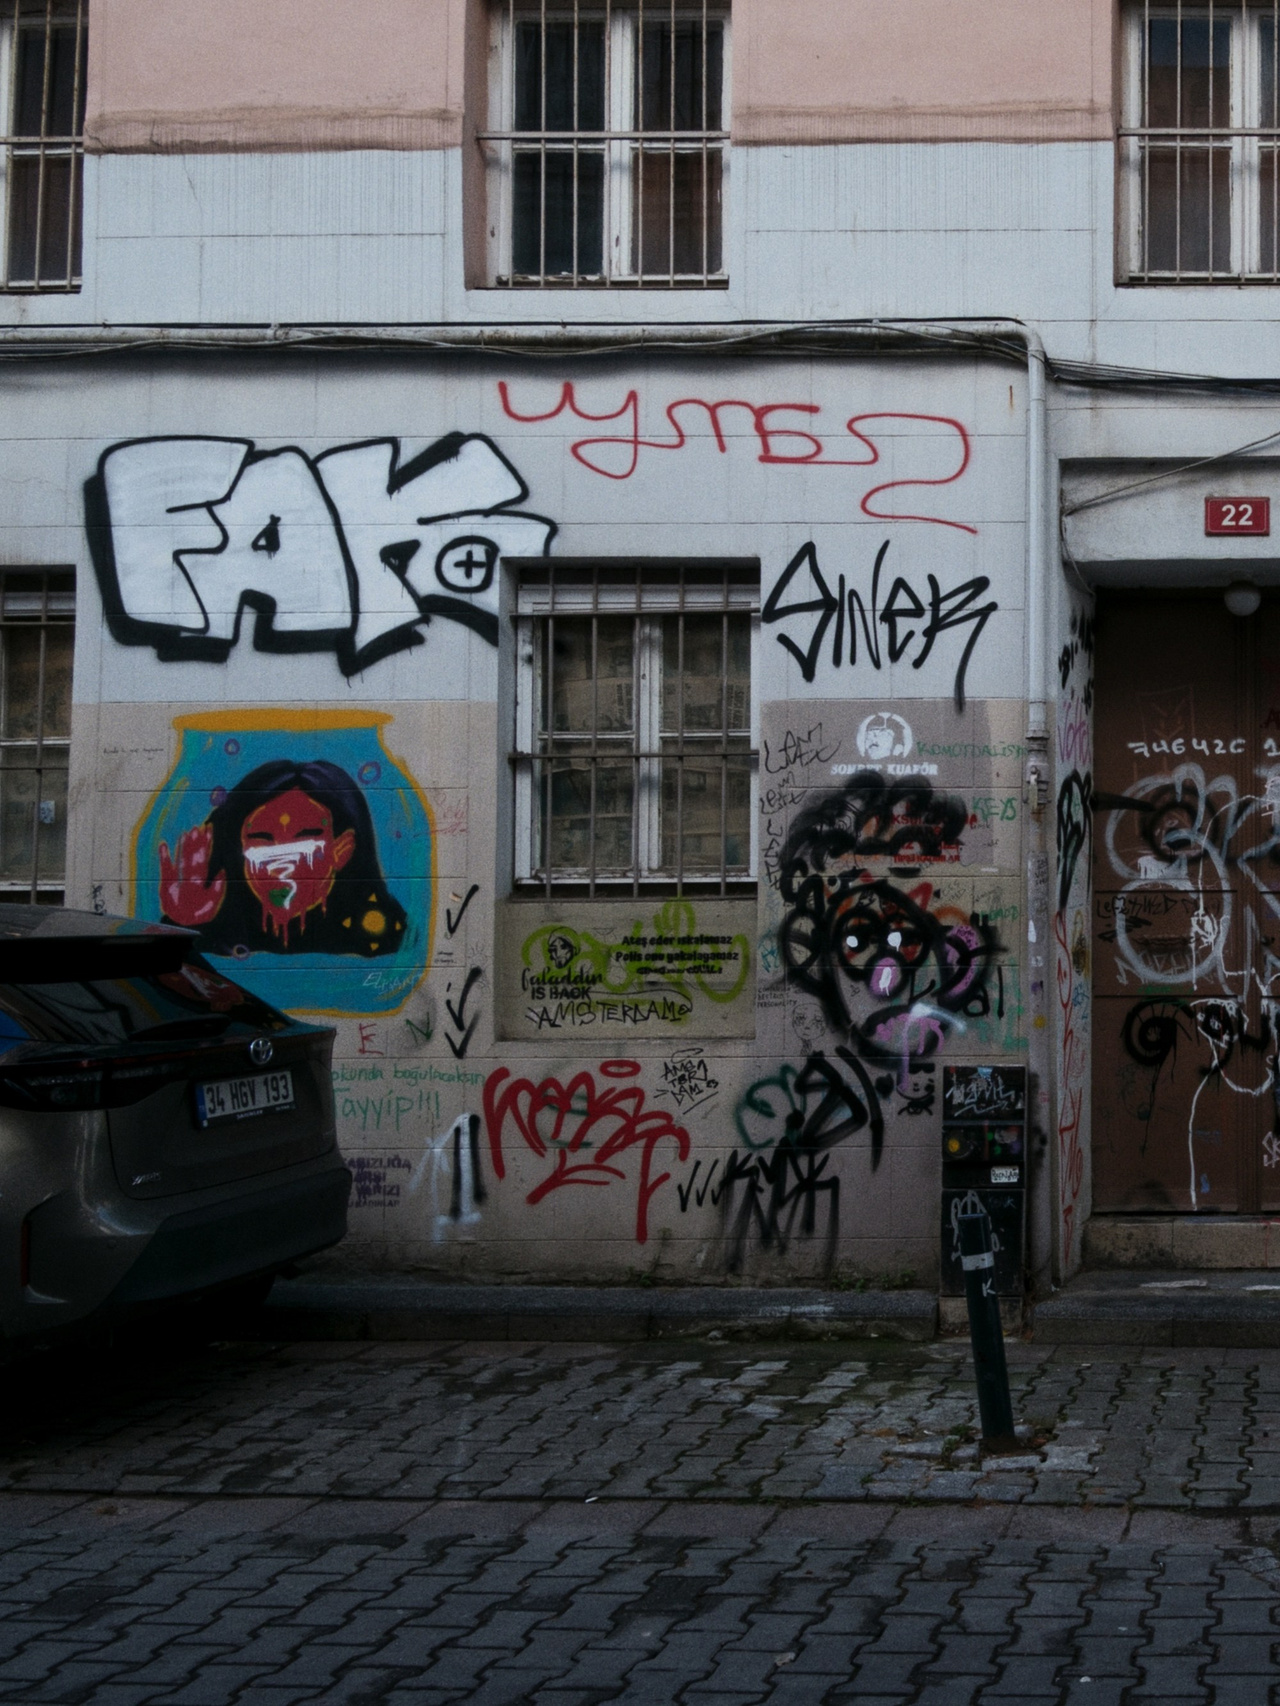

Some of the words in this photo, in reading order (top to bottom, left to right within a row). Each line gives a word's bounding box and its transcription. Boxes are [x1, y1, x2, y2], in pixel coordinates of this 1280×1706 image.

[1222, 504, 1253, 526] 22
[621, 936, 648, 948] Ateş
[649, 936, 675, 945] eder
[615, 951, 643, 962] Polis
[531, 987, 546, 999] IS
[206, 1085, 225, 1114] 34
[229, 1079, 257, 1110] HGV
[263, 1073, 290, 1103] 193
